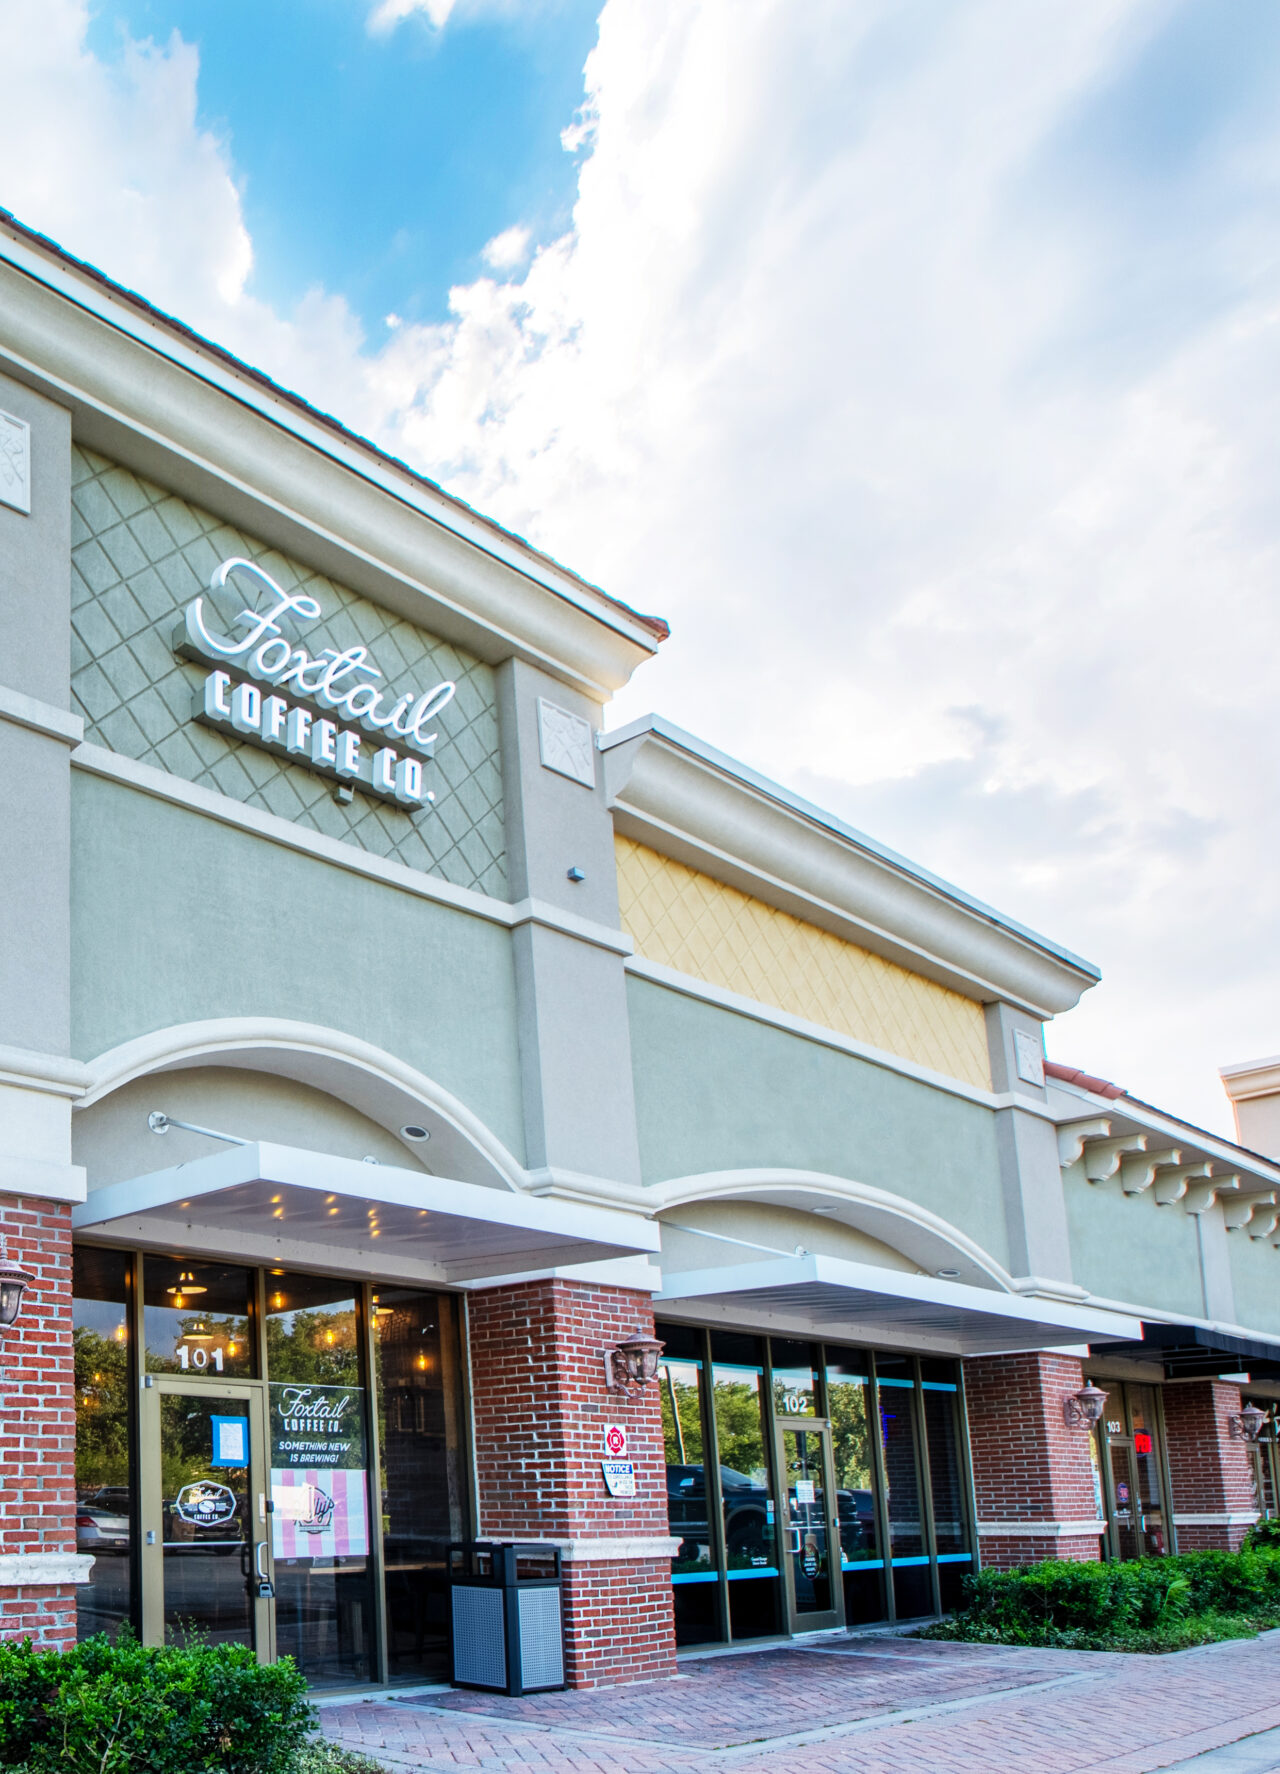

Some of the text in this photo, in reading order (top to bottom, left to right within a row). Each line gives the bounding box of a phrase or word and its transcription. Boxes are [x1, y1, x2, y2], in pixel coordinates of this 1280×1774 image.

[187, 557, 455, 749] Foxtail
[205, 670, 435, 803] COFFEE CO.
[176, 1345, 223, 1371] 101
[278, 1387, 350, 1418] Foxtail
[782, 1395, 808, 1412] 102
[284, 1419, 343, 1433] COFFEE CO.
[1107, 1421, 1120, 1433] 103
[279, 1441, 351, 1451] SOMETHING NEW
[290, 1454, 339, 1463] IS BREWING!
[605, 1464, 631, 1474] NOTICE
